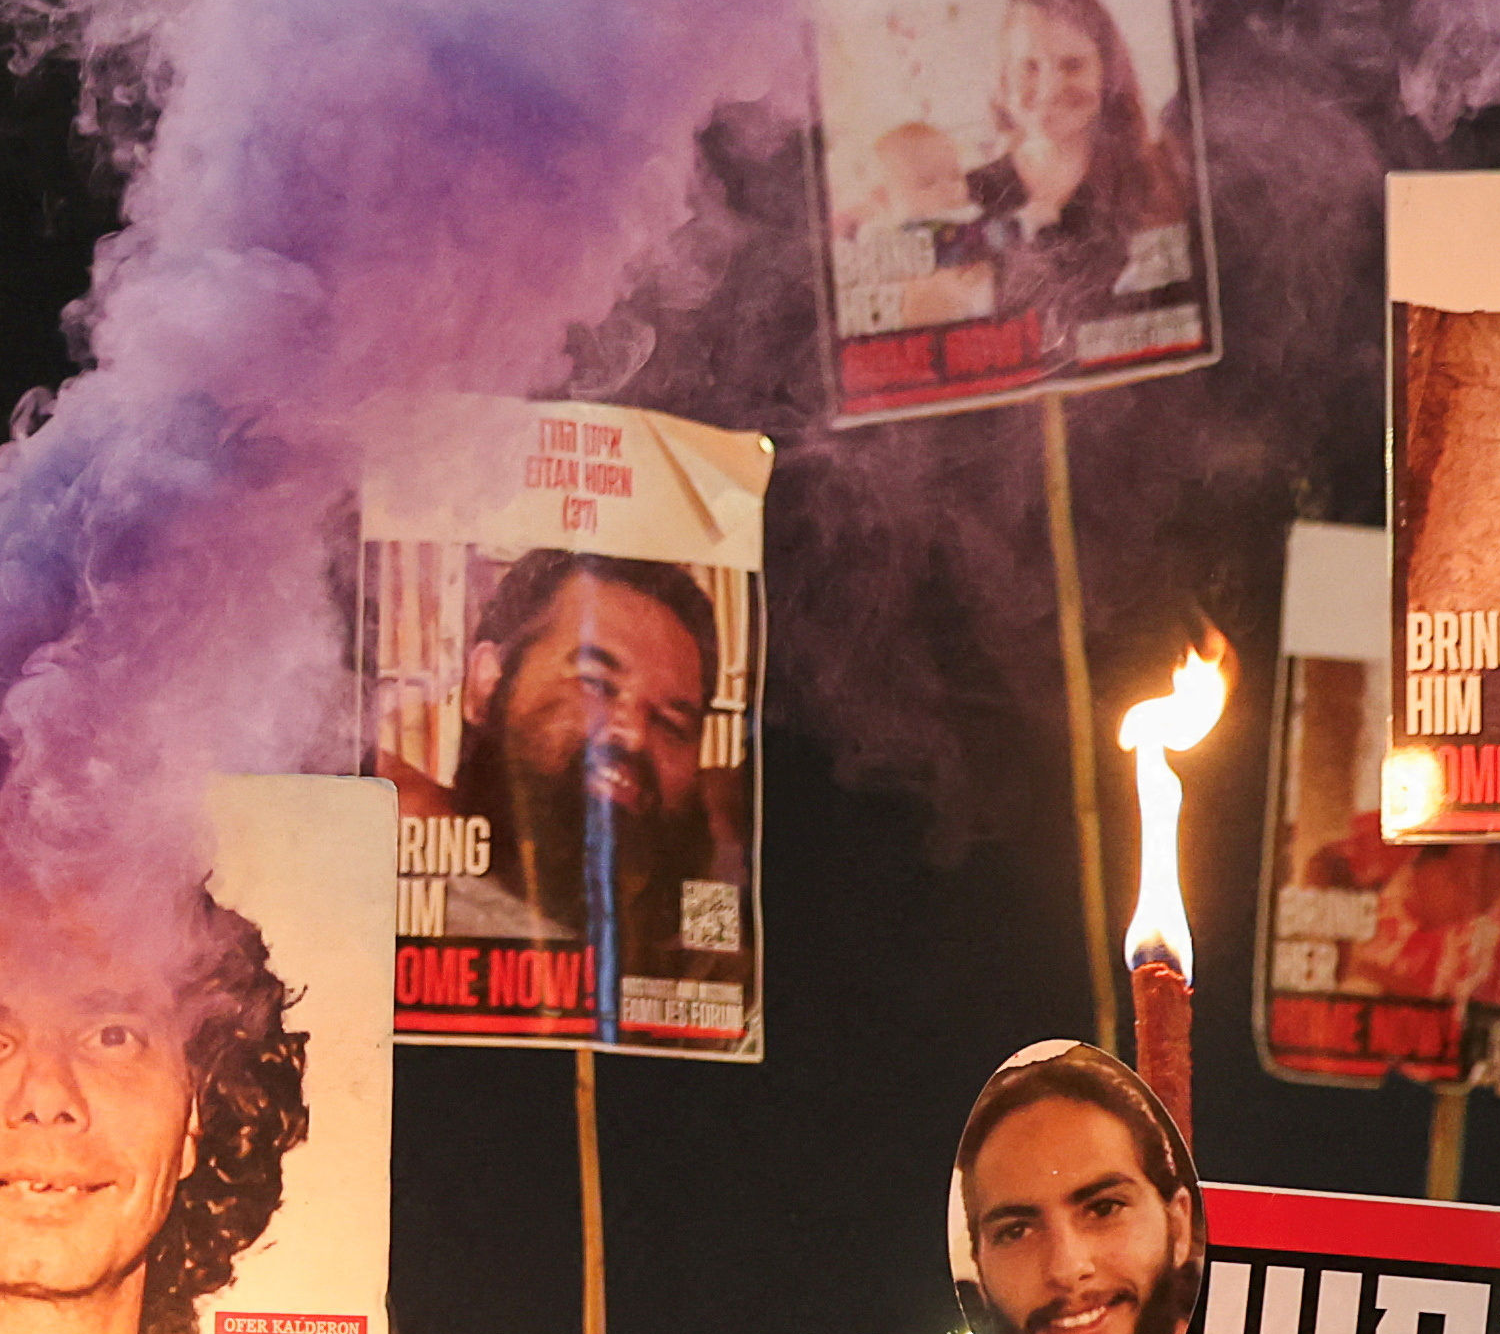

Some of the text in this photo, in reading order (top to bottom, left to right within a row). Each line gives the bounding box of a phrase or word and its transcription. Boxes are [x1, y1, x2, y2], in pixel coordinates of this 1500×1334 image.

[525, 454, 632, 498] EITAN HORN
[1405, 672, 1482, 735] HIM
[399, 816, 491, 876] RING
[399, 878, 447, 937] IM
[398, 946, 480, 1006] OME
[488, 944, 597, 1010] NOW!
[224, 1317, 268, 1333] OFER
